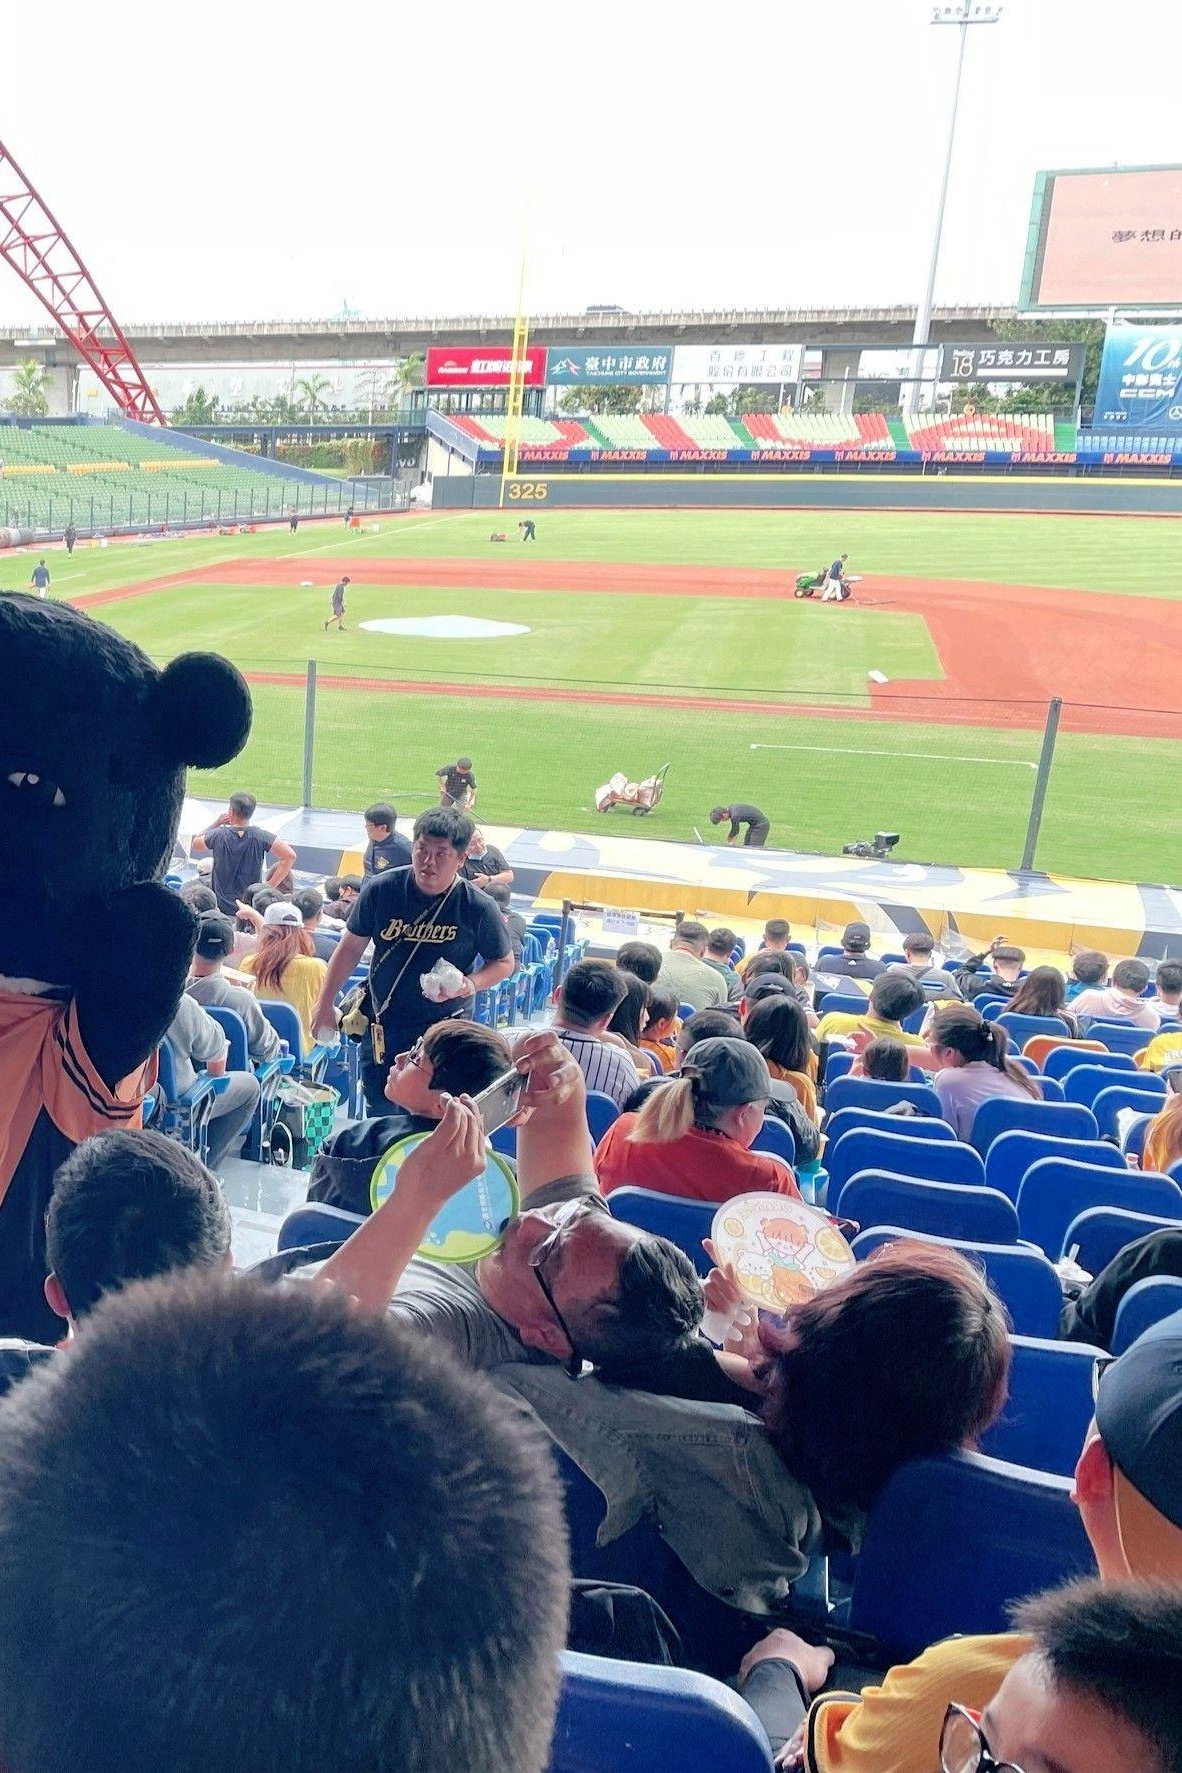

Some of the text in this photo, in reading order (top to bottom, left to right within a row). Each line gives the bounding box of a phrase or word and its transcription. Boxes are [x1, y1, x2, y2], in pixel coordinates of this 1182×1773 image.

[585, 355, 667, 371] 臺中市政府
[978, 349, 1070, 366] 巧克力工房
[708, 365, 792, 377] 股份有限公司
[950, 356, 974, 377] 18
[1120, 388, 1175, 398] CCM
[524, 451, 568, 461] MAXXIS
[601, 450, 647, 461] MAXXIS
[679, 450, 728, 461] MAXXIS
[762, 450, 811, 460] MAXXIS
[847, 450, 897, 461] MAXXIS
[933, 451, 985, 462] MAXXIS
[1022, 451, 1077, 462] MAXXIS
[1116, 452, 1172, 463] MAXXIS
[508, 483, 548, 500] 325
